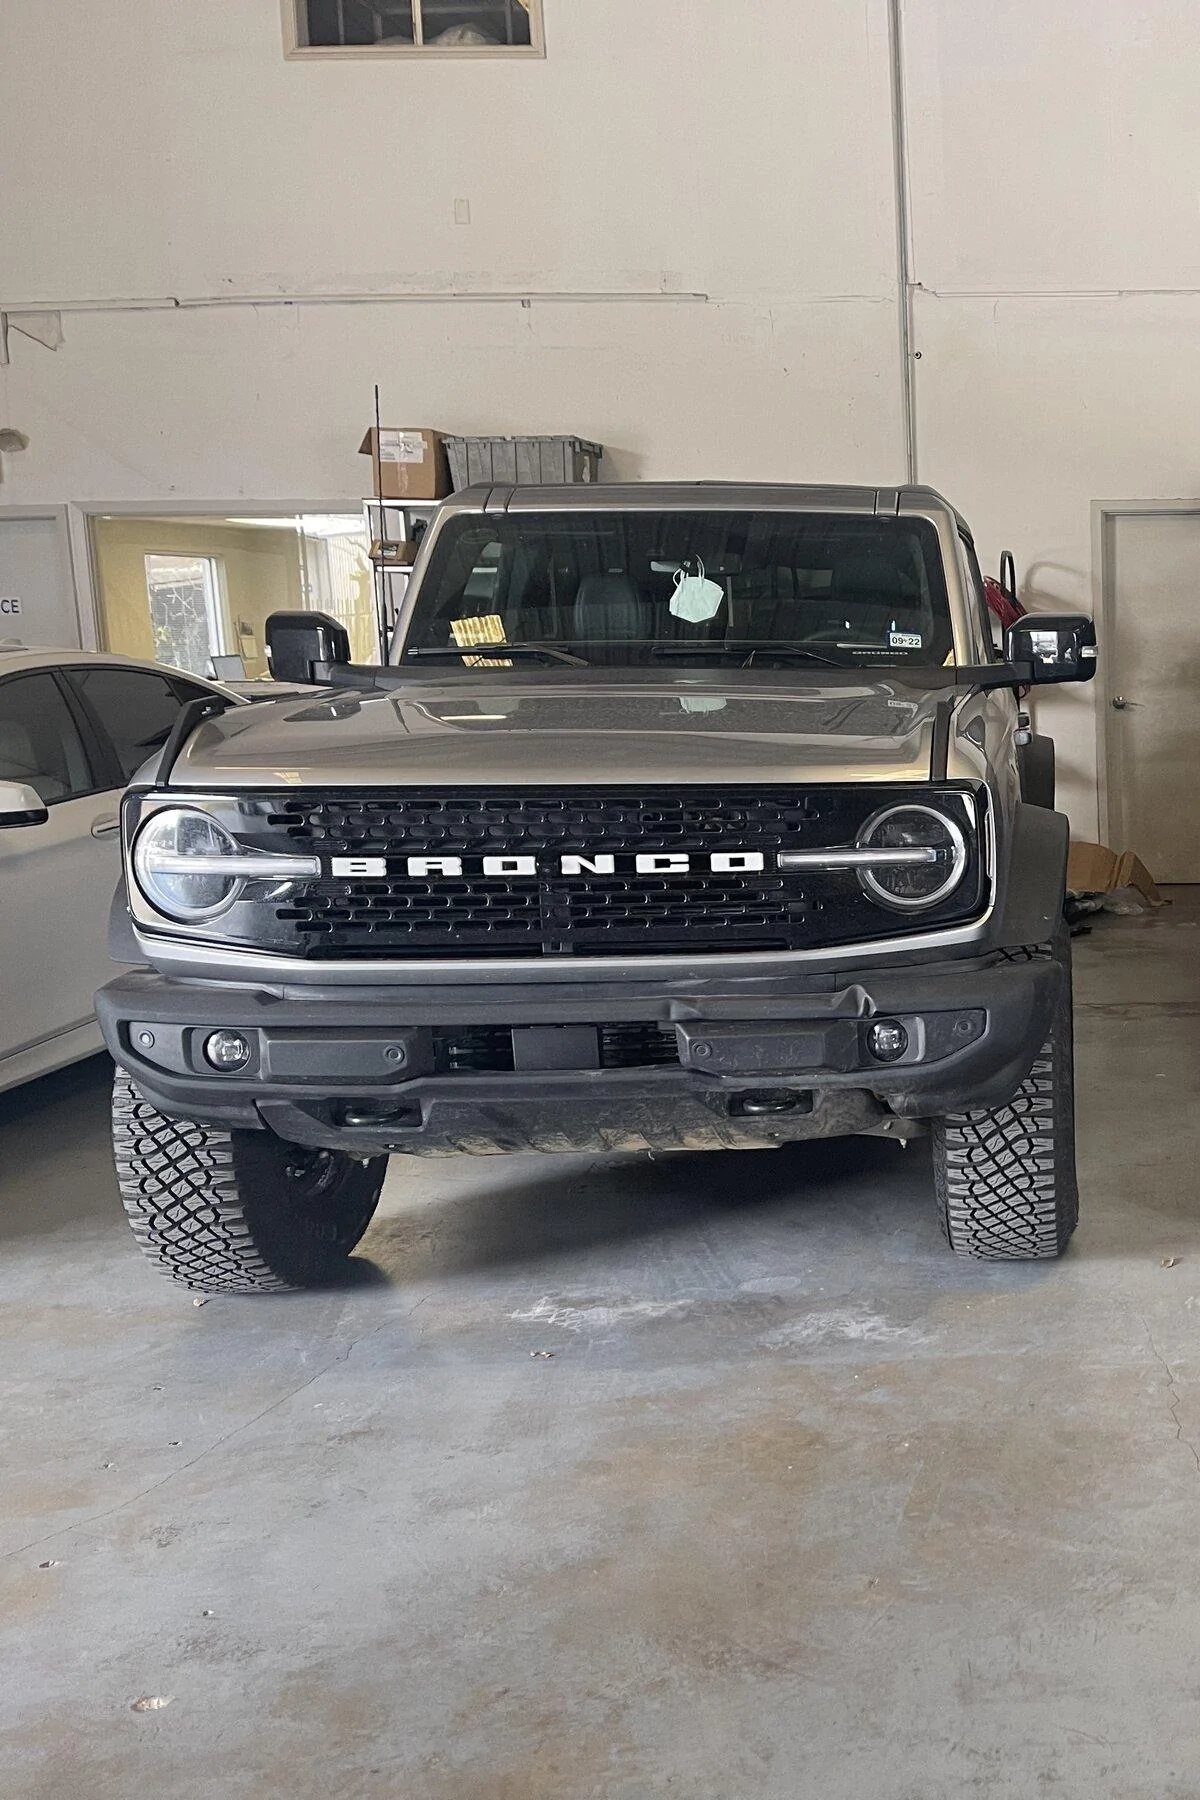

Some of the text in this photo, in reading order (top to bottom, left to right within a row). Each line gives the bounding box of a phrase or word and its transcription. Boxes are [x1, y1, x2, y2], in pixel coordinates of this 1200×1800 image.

[892, 636, 920, 646] 09 22
[331, 853, 764, 877] BRONCO
